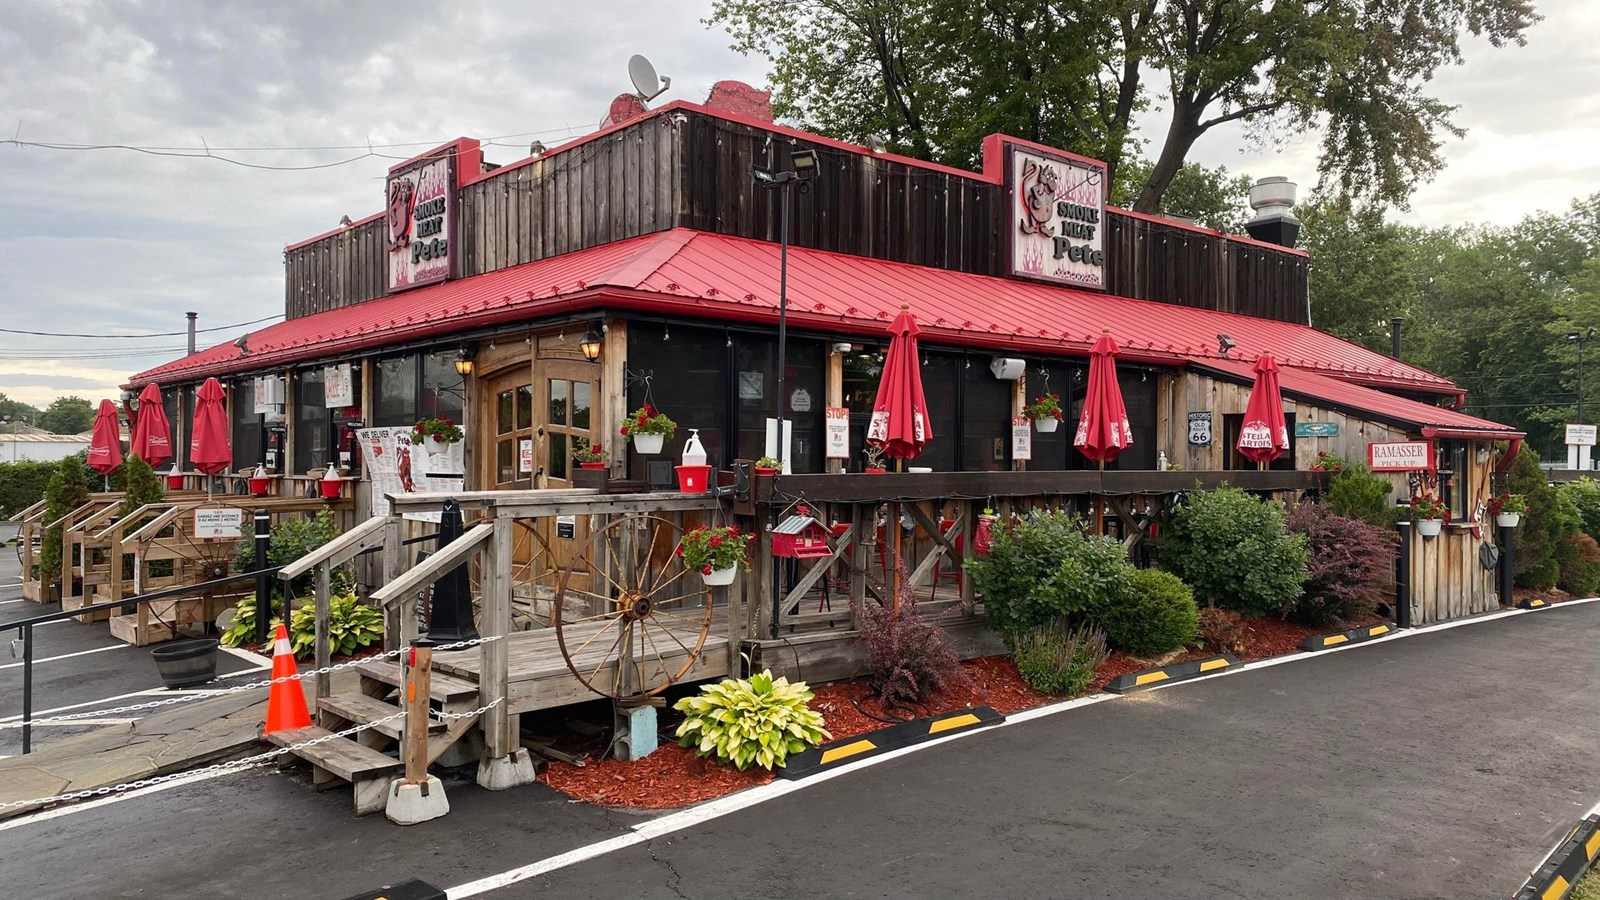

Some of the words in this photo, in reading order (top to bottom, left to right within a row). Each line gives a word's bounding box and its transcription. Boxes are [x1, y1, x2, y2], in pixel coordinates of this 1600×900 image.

[414, 197, 446, 221] SMOKE
[1057, 201, 1099, 223] SMOKE
[417, 217, 443, 239] MEAT
[1061, 220, 1096, 240] MEAT
[411, 238, 447, 264] Pete
[1052, 236, 1104, 266] Pete
[1189, 412, 1211, 420] HISTORIC
[370, 430, 389, 438] DELIVER
[1192, 432, 1207, 442] 66
[1374, 445, 1423, 458] RAMASSER
